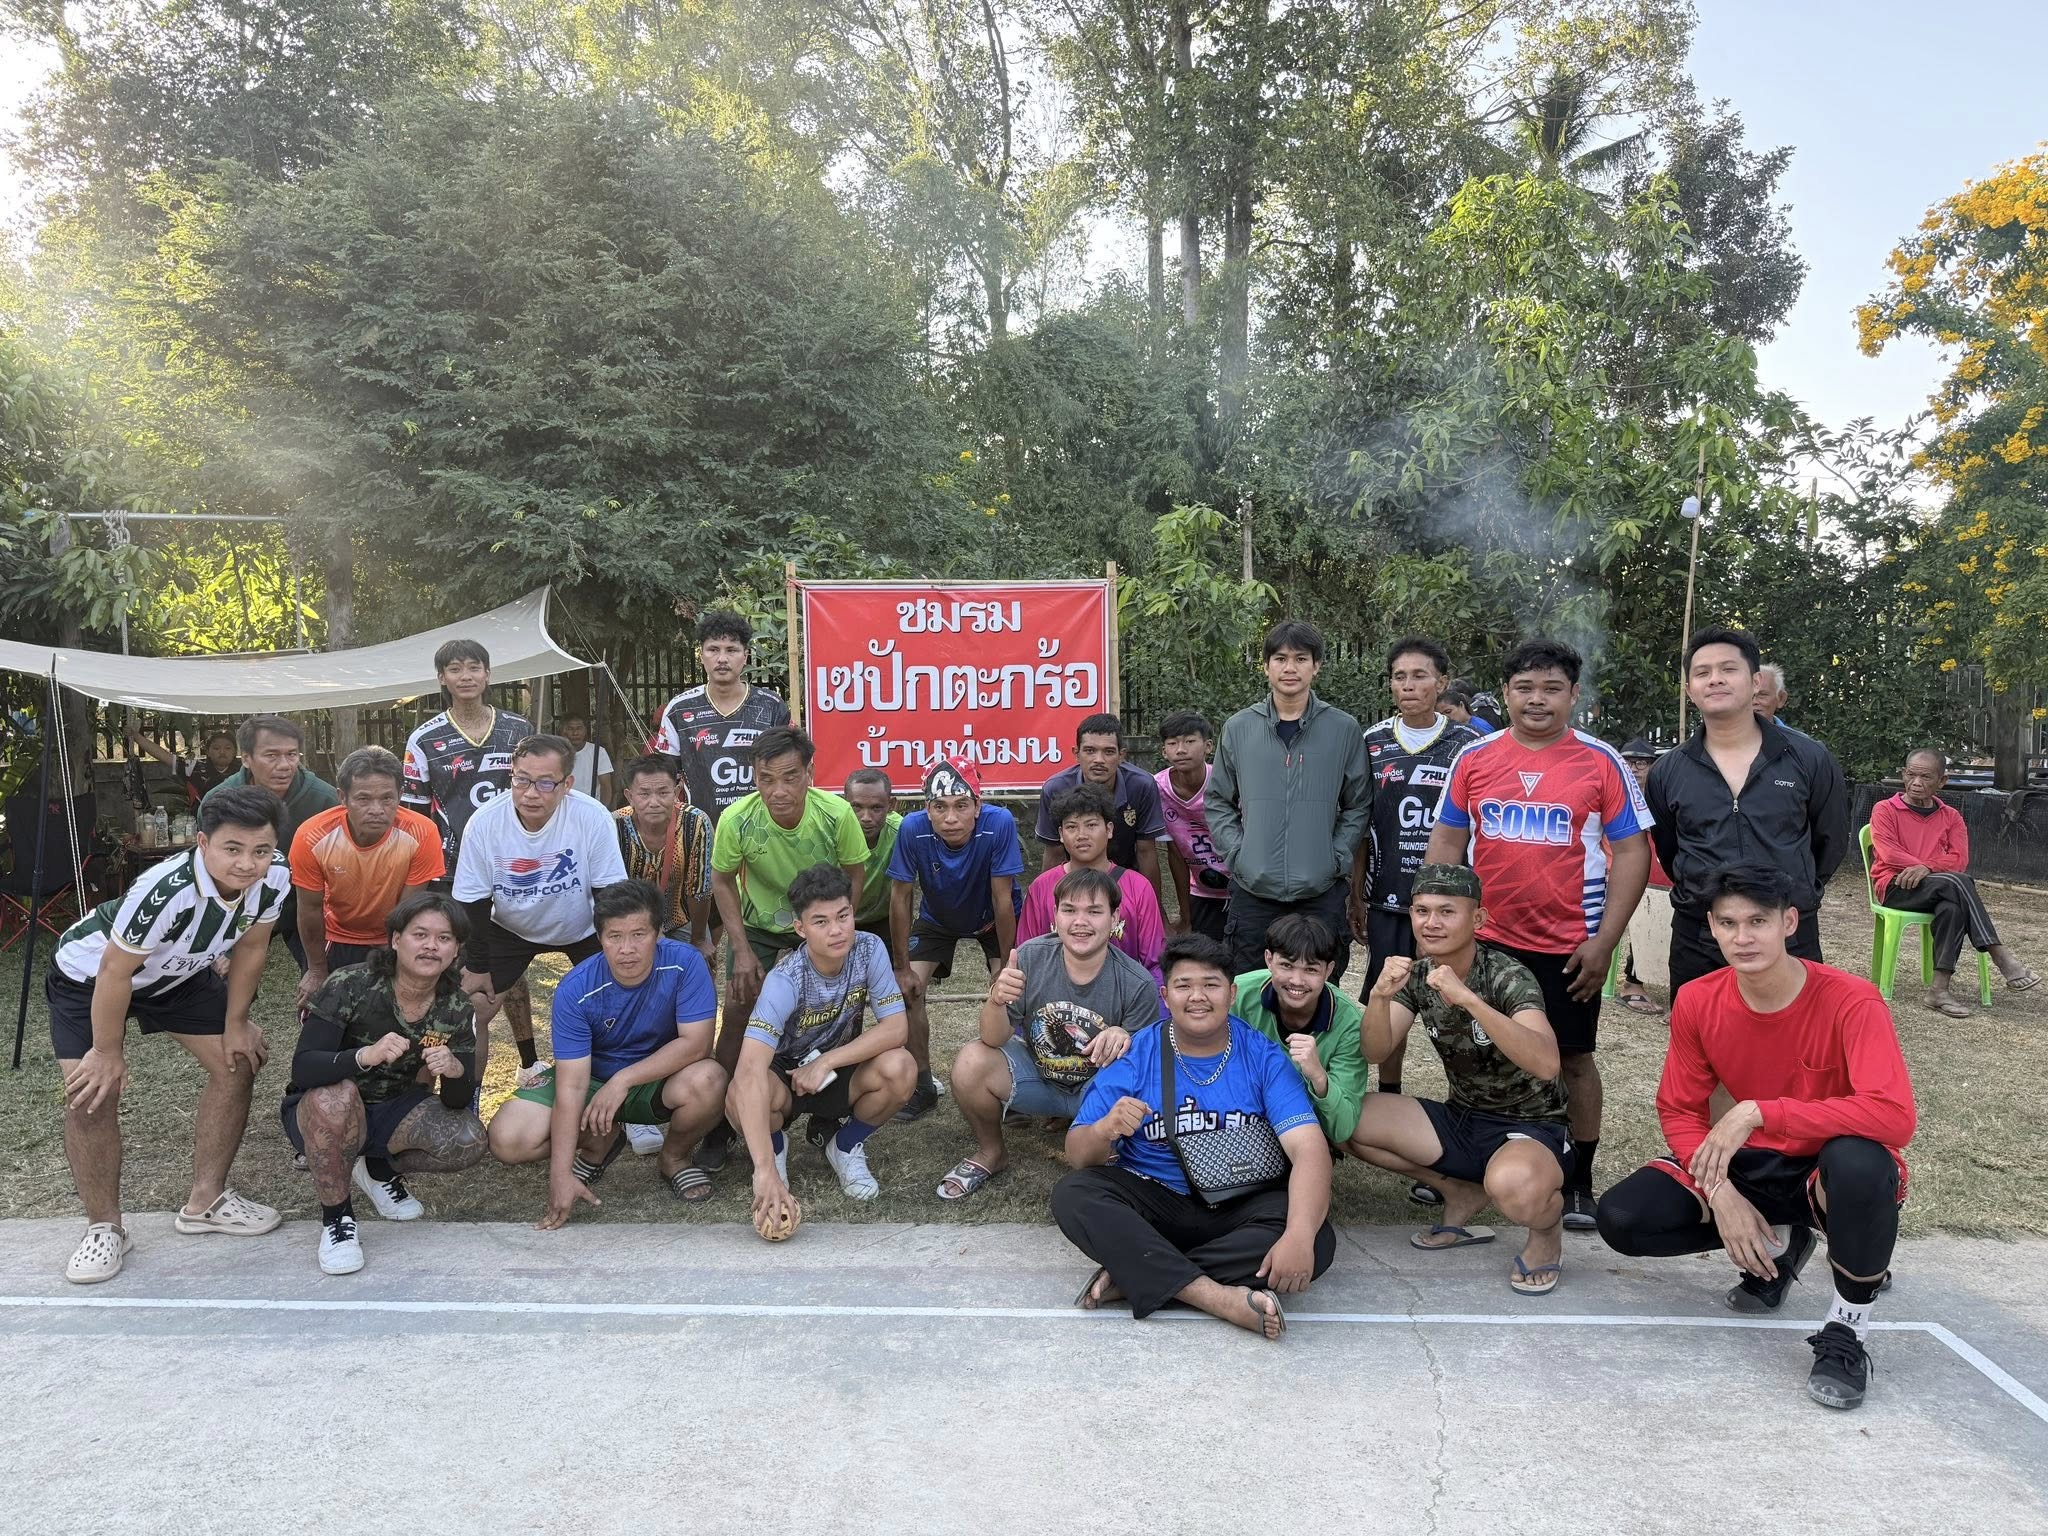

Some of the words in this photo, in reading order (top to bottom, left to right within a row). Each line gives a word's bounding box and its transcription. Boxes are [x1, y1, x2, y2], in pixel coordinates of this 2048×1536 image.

[896, 598, 1022, 633] ชมรม
[816, 638, 1098, 712] เซปักตะกร้อ
[856, 723, 1063, 768] บ้านท่งมน
[442, 759, 473, 772] Thunder
[1373, 768, 1404, 780] Thunder
[1480, 800, 1571, 844] SONG
